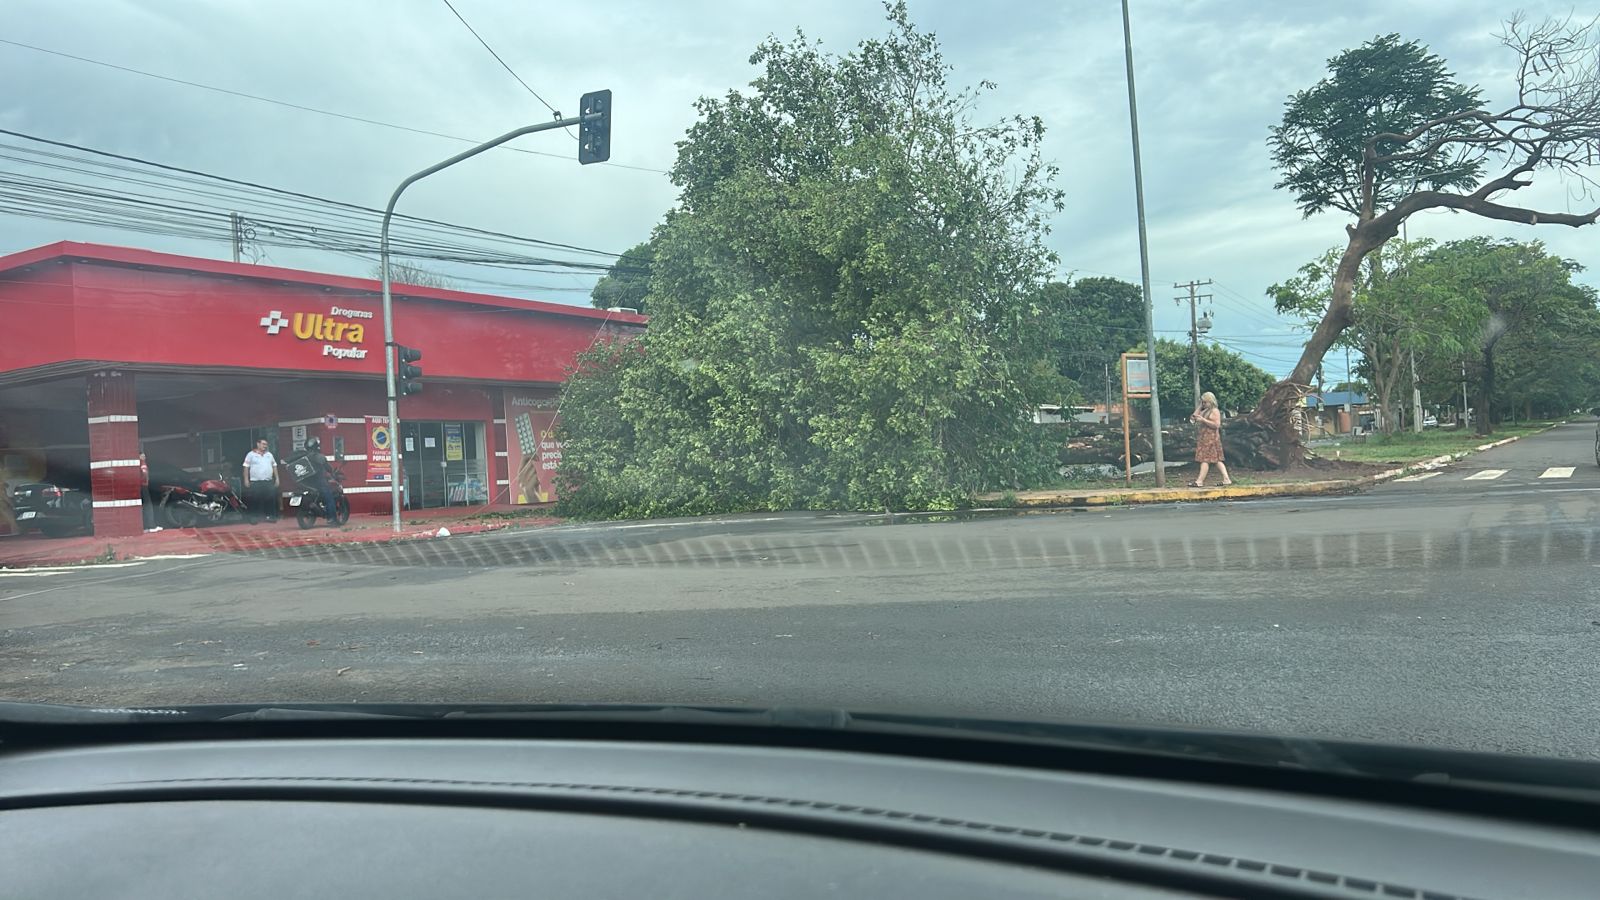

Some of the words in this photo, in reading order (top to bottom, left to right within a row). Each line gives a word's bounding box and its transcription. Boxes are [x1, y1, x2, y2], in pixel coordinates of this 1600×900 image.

[331, 306, 373, 318] Drogarias
[293, 312, 364, 343] Ultra
[323, 345, 368, 359] Popular
[541, 450, 563, 461] precis
